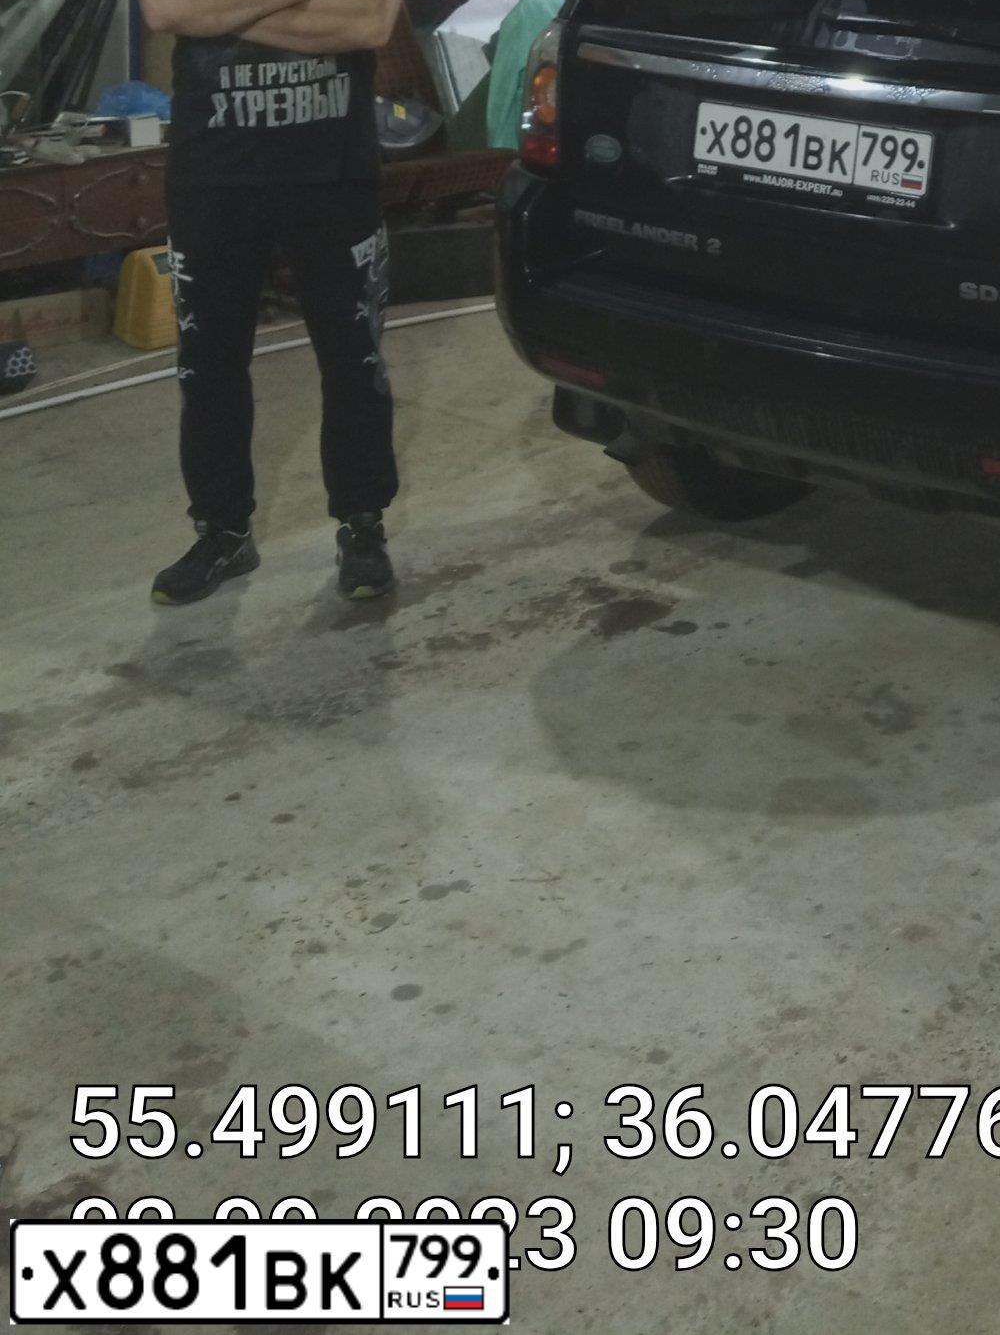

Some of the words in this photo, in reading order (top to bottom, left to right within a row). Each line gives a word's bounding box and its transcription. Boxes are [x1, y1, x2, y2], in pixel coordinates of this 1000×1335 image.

[235, 64, 253, 87] НЕ
[231, 72, 350, 127] ТРЕЗВЫЙ
[861, 131, 919, 173] 799
[870, 169, 900, 186] RUS
[574, 208, 699, 251] FREELANDER
[706, 237, 723, 255] 2
